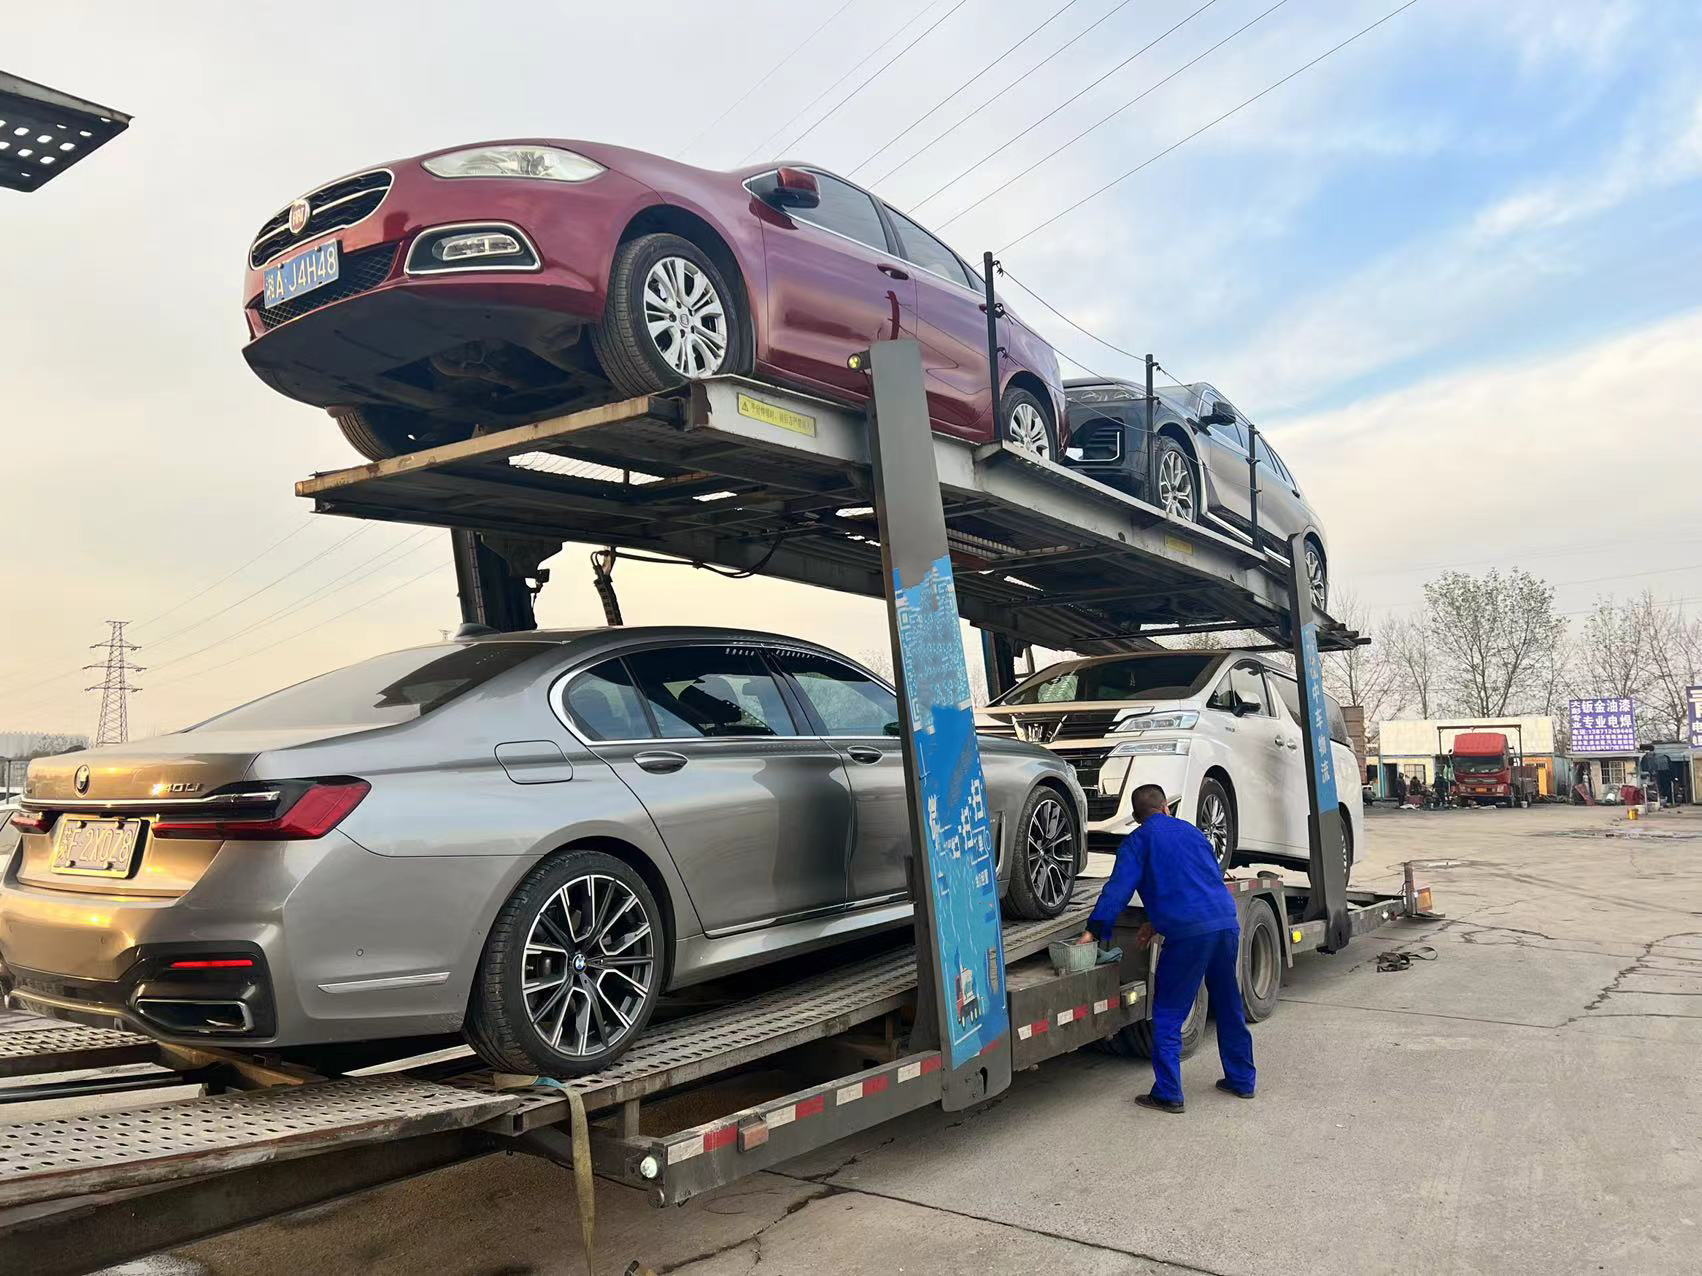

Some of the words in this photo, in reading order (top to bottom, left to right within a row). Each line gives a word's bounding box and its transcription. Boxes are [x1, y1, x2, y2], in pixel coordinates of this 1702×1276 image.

[1582, 699, 1631, 713] 钣金油漆
[1582, 714, 1632, 728] 专业电焊
